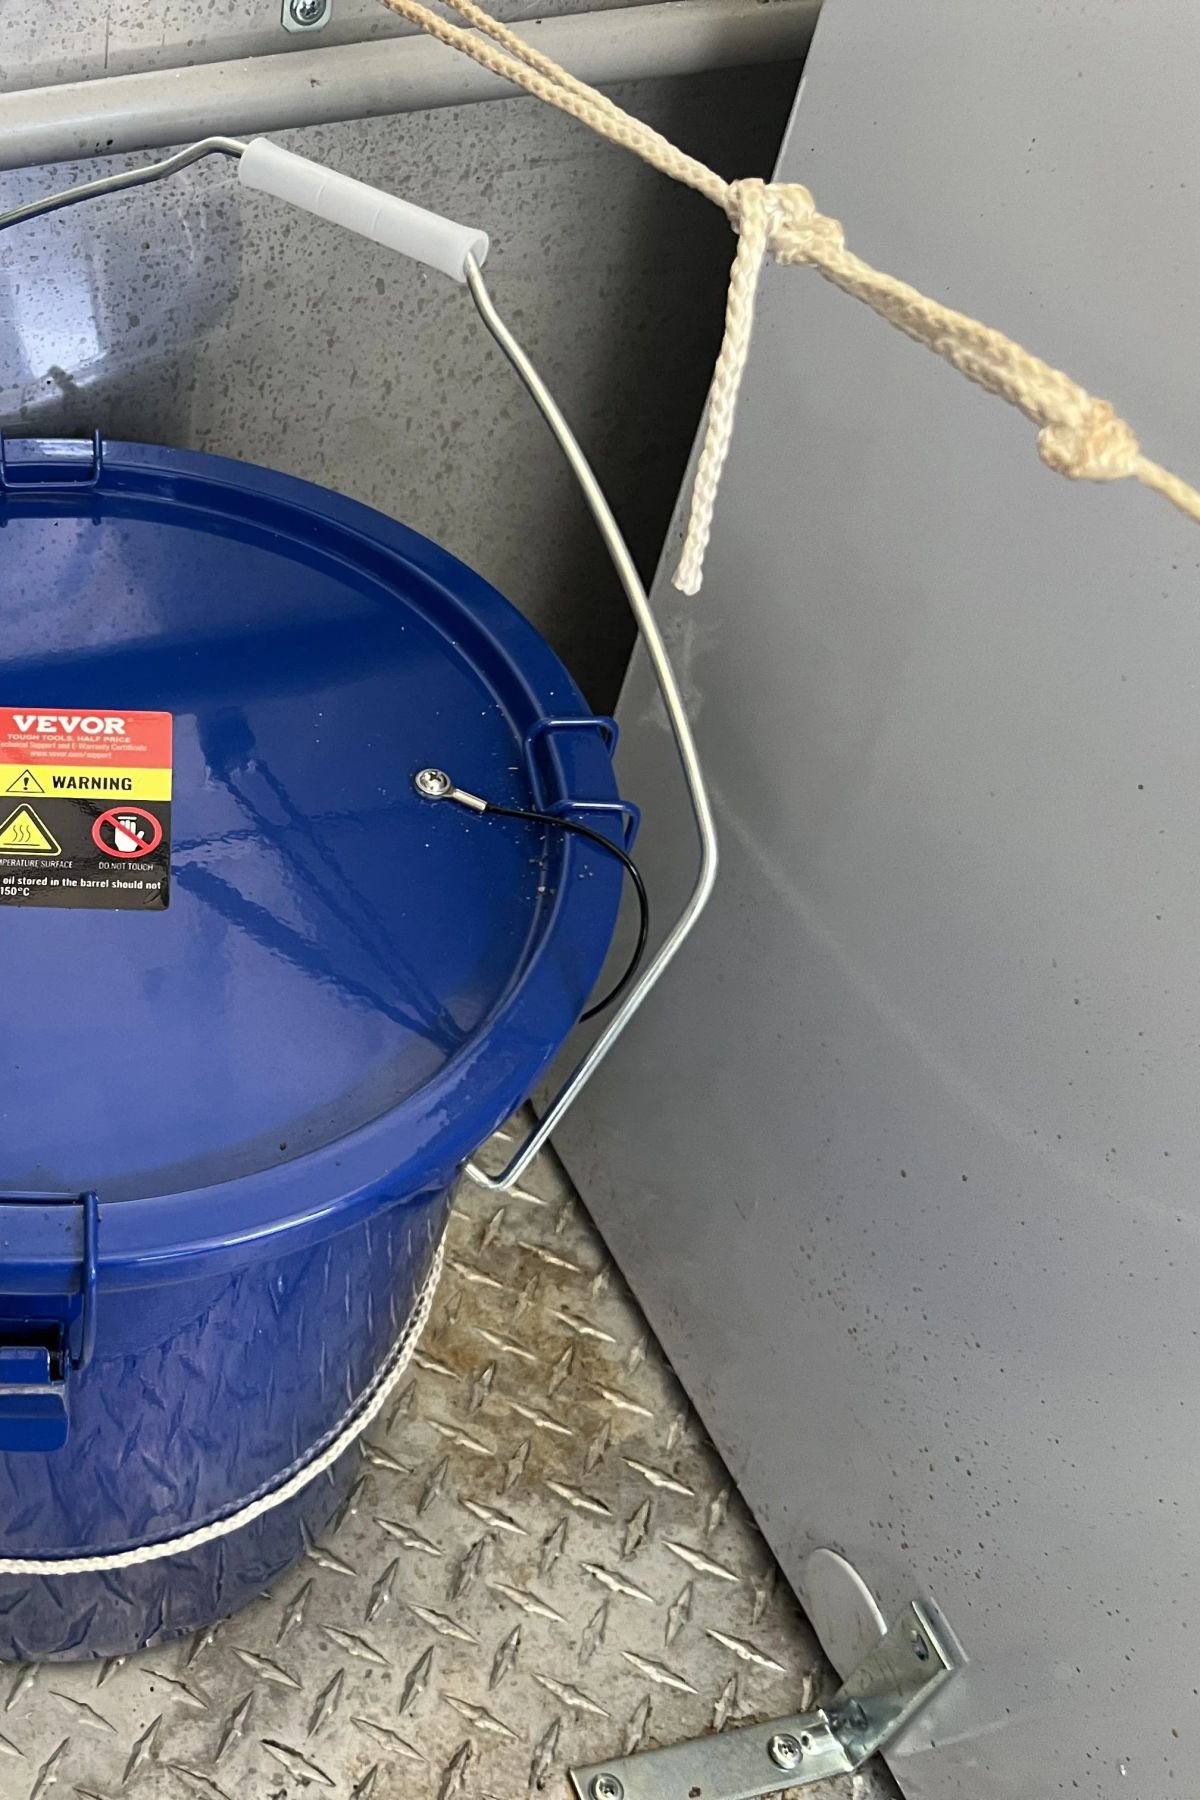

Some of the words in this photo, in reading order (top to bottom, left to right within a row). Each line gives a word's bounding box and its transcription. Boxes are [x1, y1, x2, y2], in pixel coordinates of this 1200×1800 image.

[12, 715, 125, 734] VEVOR
[7, 733, 40, 741] TOUGH
[29, 741, 56, 750] Support
[52, 776, 132, 791] WARNING
[40, 860, 73, 869] SURFACE
[98, 861, 110, 870] DO
[111, 862, 126, 870] NOT
[127, 863, 154, 871] TOUCH
[3, 876, 15, 885] oil
[17, 877, 48, 886] stored
[50, 877, 59, 886] in
[62, 878, 78, 887] the
[80, 878, 109, 888] barrel
[111, 880, 143, 890] should
[145, 881, 161, 890] not
[0, 886, 30, 896] 150°C
